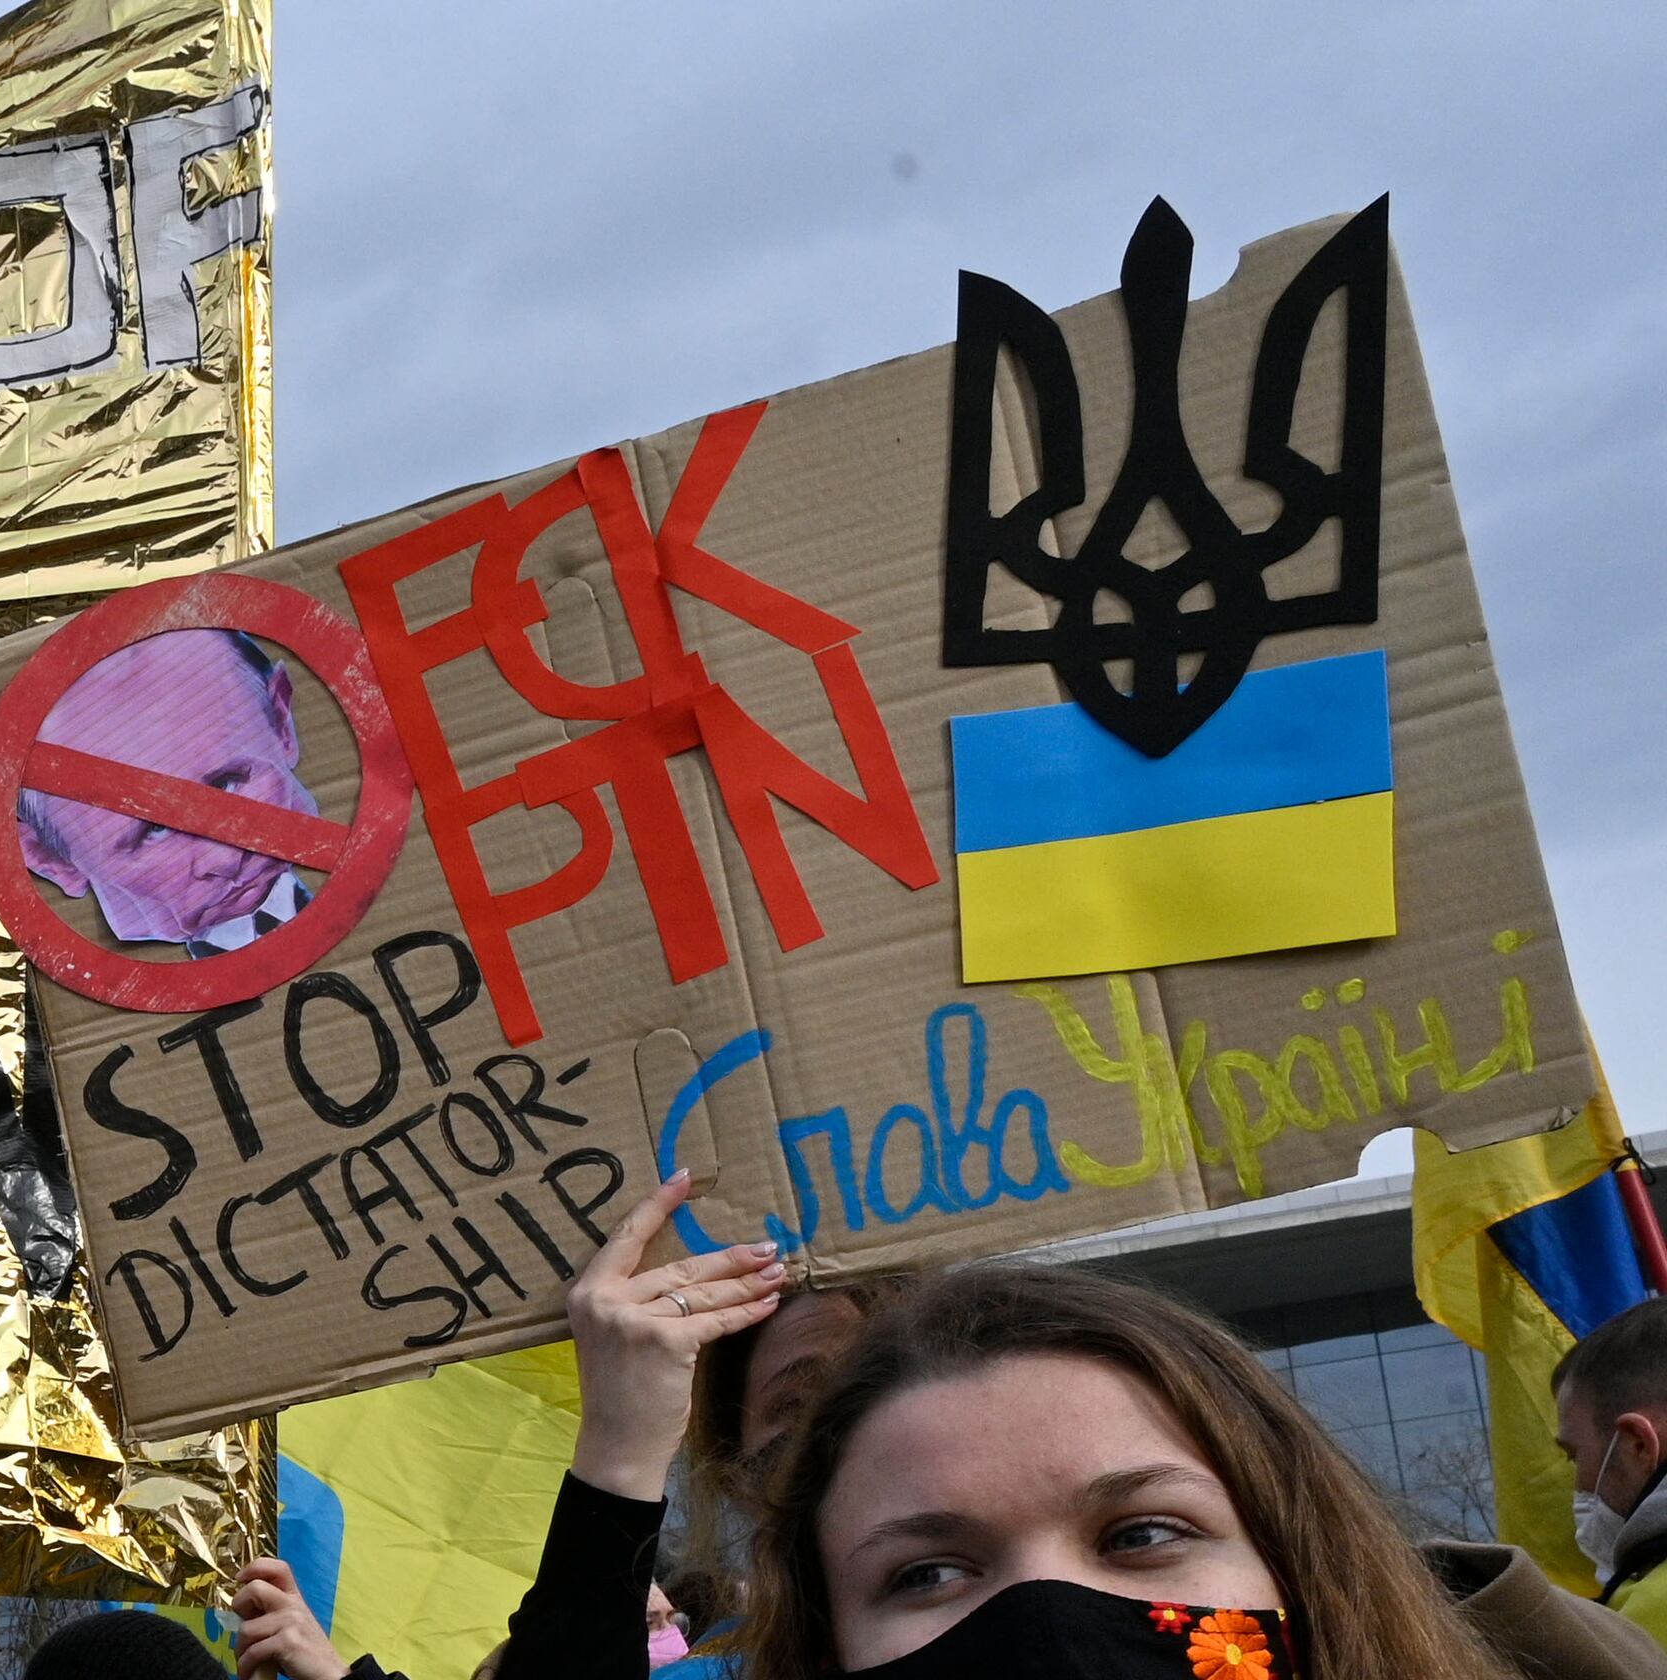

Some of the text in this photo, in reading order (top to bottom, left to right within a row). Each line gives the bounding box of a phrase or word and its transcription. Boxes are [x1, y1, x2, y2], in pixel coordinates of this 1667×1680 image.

[339, 401, 862, 792] FCK
[83, 930, 481, 1219] STOP
[105, 1054, 591, 1361] DICTATOR-
[654, 929, 1533, 1255] Слава Україні
[363, 1147, 623, 1347] SHIP
